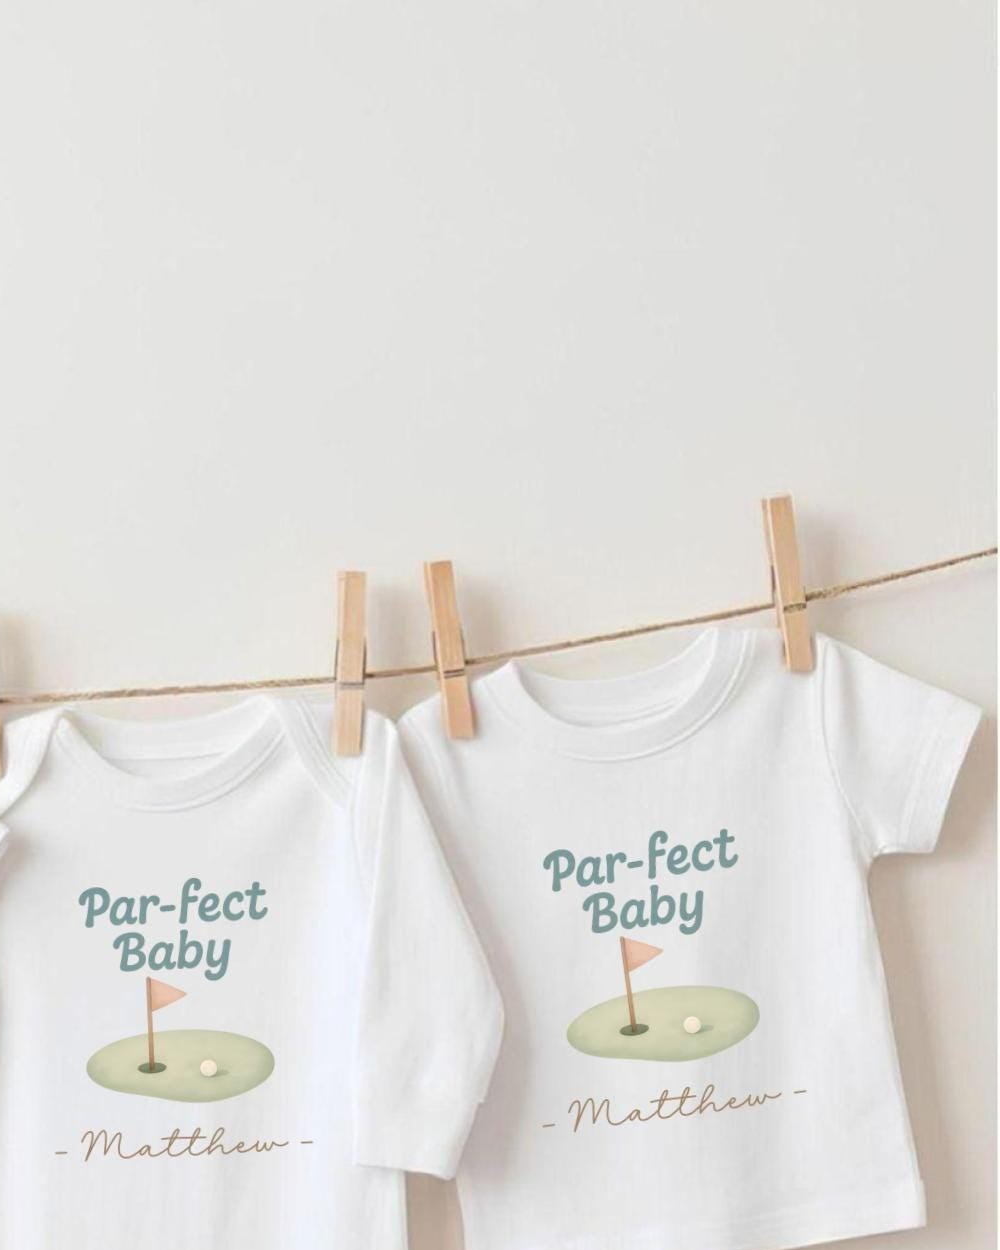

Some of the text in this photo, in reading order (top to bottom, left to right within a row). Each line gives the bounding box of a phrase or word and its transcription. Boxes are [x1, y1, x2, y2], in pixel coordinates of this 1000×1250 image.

[543, 829, 740, 892] Par-fect
[78, 878, 268, 928] Par-fect
[582, 885, 704, 935] Baby
[113, 929, 231, 981] Baby
[567, 1083, 783, 1134] Matthew
[80, 1126, 290, 1163] Matthew
